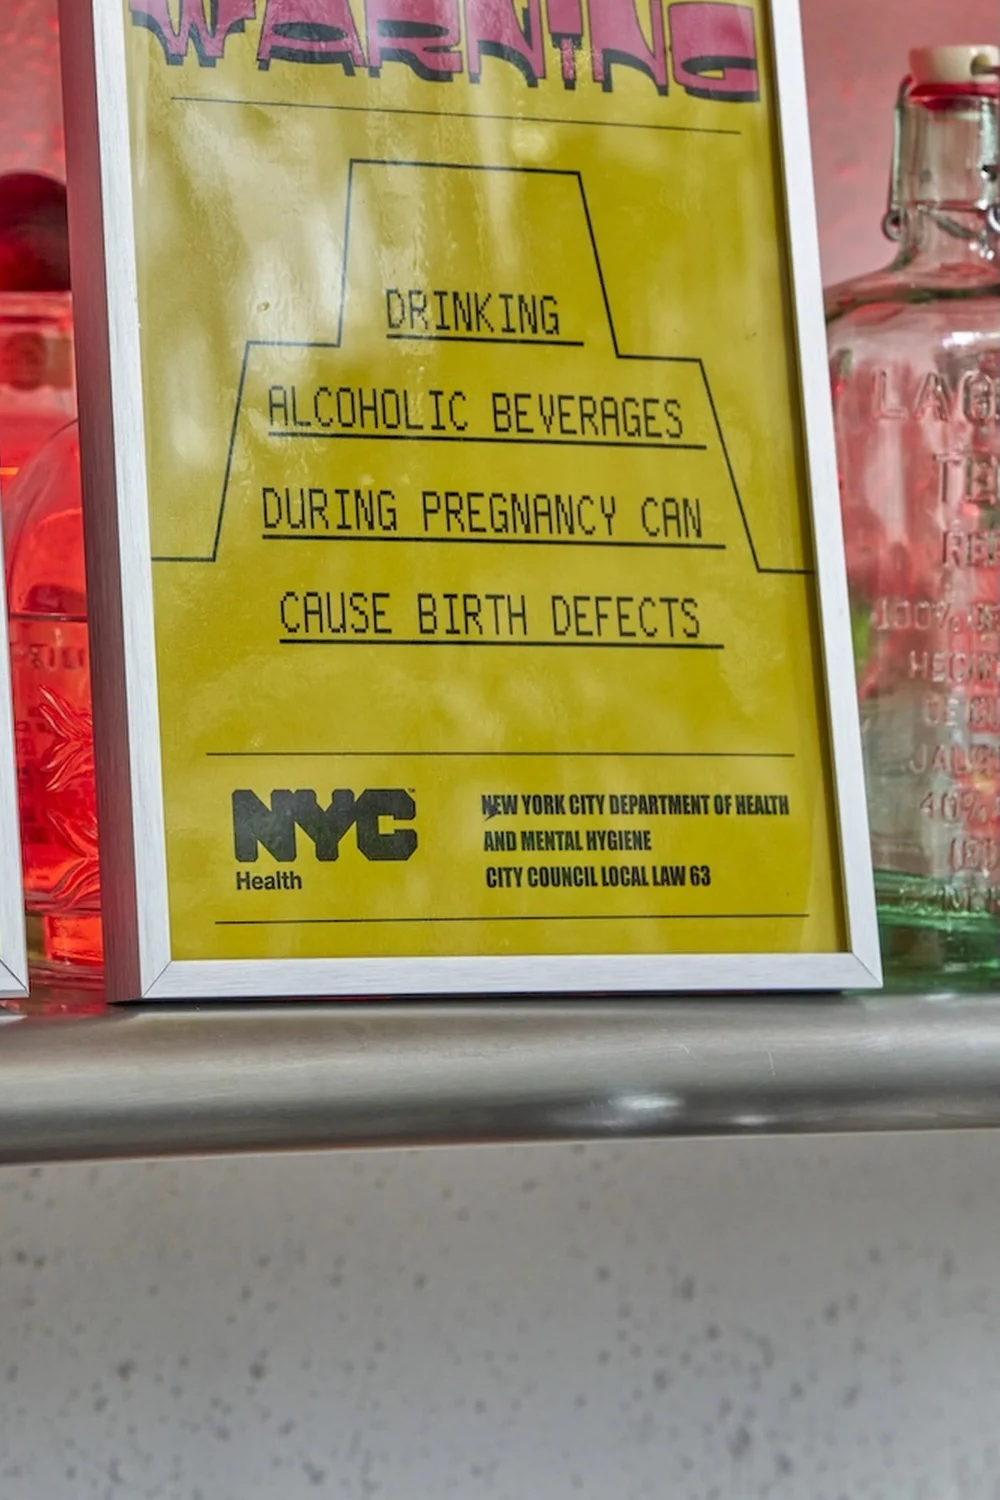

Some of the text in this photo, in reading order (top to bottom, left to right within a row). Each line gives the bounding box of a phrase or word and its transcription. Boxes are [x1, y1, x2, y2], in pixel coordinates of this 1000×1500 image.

[385, 287, 561, 336] DRINKING
[268, 385, 684, 439] ALCOHOLIC BEVERAGES
[262, 486, 703, 539] DURING PREGNANCY CAN
[279, 590, 701, 638] CAUSE BIRTH DEFECTS
[231, 788, 418, 863] NYC
[482, 794, 791, 816] NEW YORK CITY DEPARTMENT OF HEALTH
[483, 829, 653, 852] AND MENTAL HYGIENE
[236, 870, 303, 890] Health
[485, 864, 711, 888] CITY COUNCIL LOCAL LAW 63
